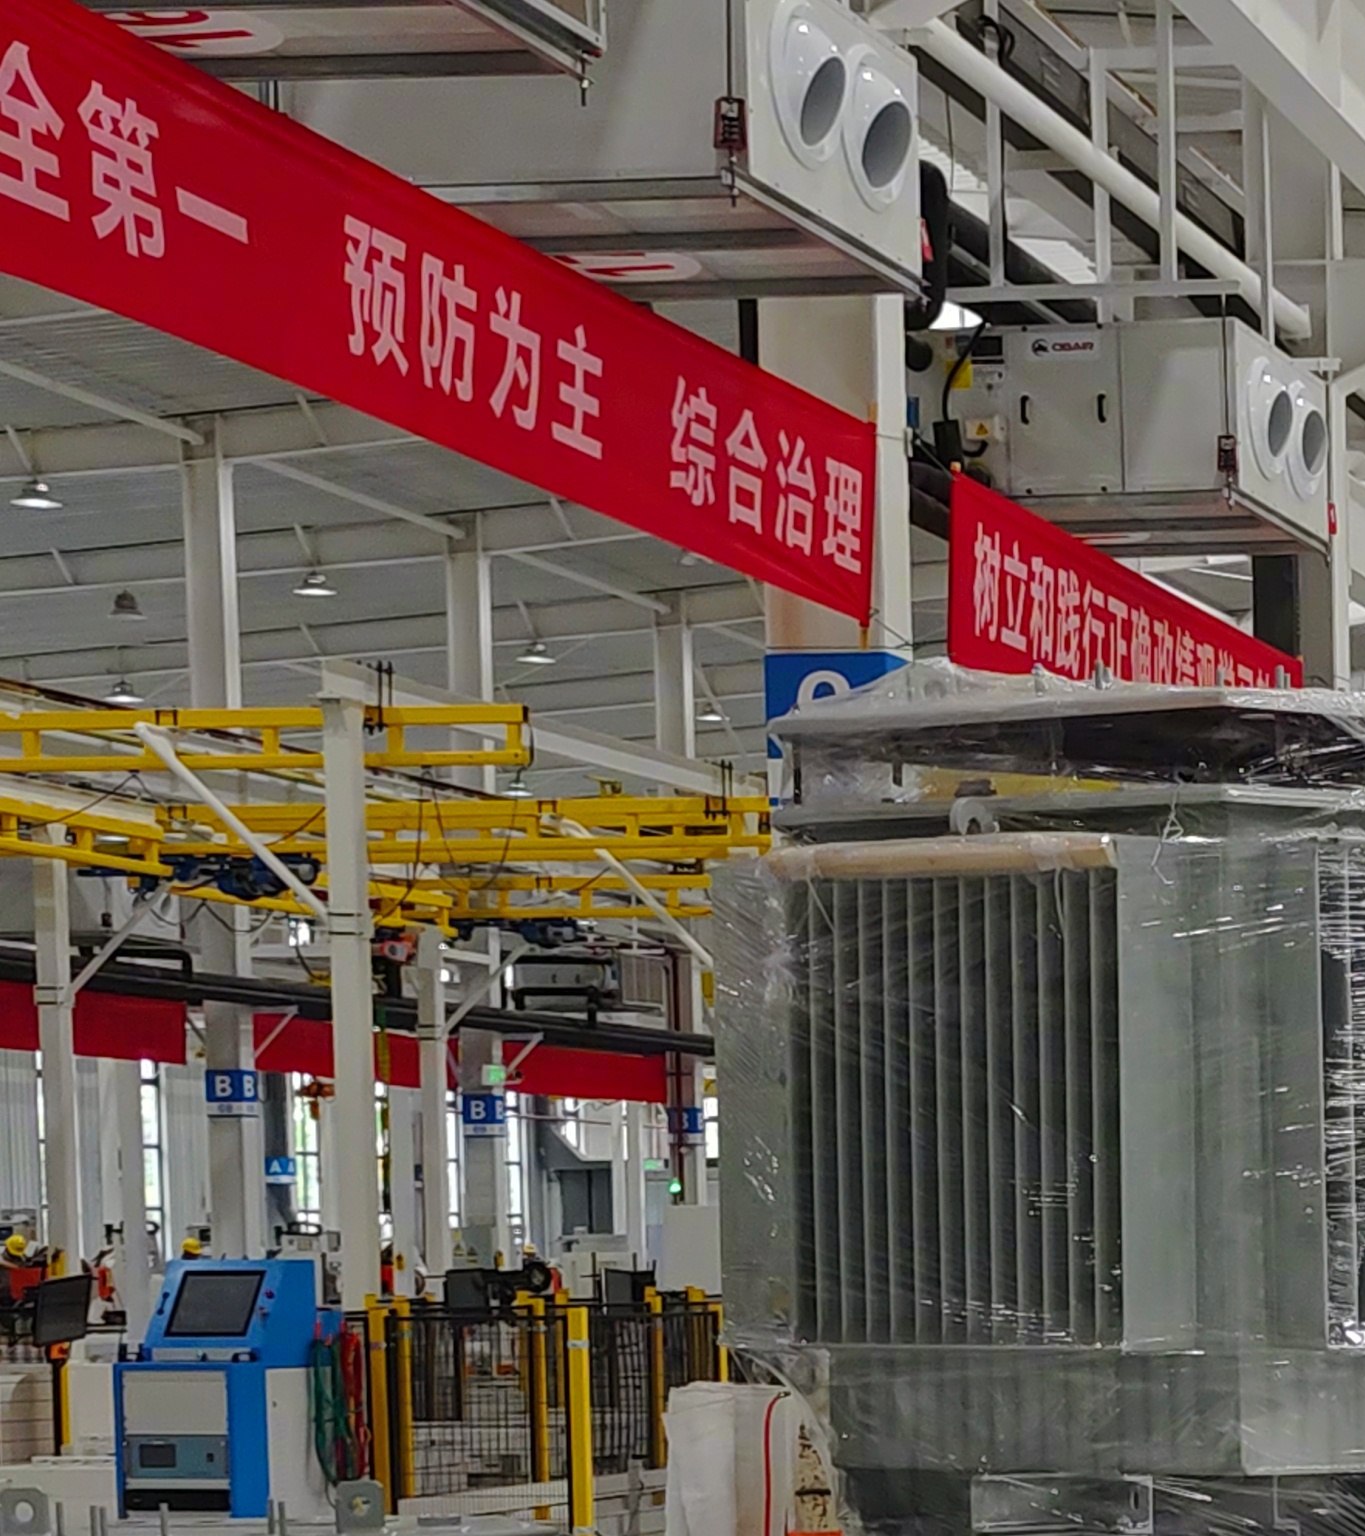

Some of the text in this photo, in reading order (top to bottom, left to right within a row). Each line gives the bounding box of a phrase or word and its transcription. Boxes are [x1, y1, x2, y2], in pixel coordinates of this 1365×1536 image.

[0, 40, 863, 575] 全第一 预防为主 综合治理
[214, 1075, 233, 1097] B
[242, 1074, 255, 1098] B
[469, 1100, 487, 1120] B
[269, 1159, 282, 1173] A
